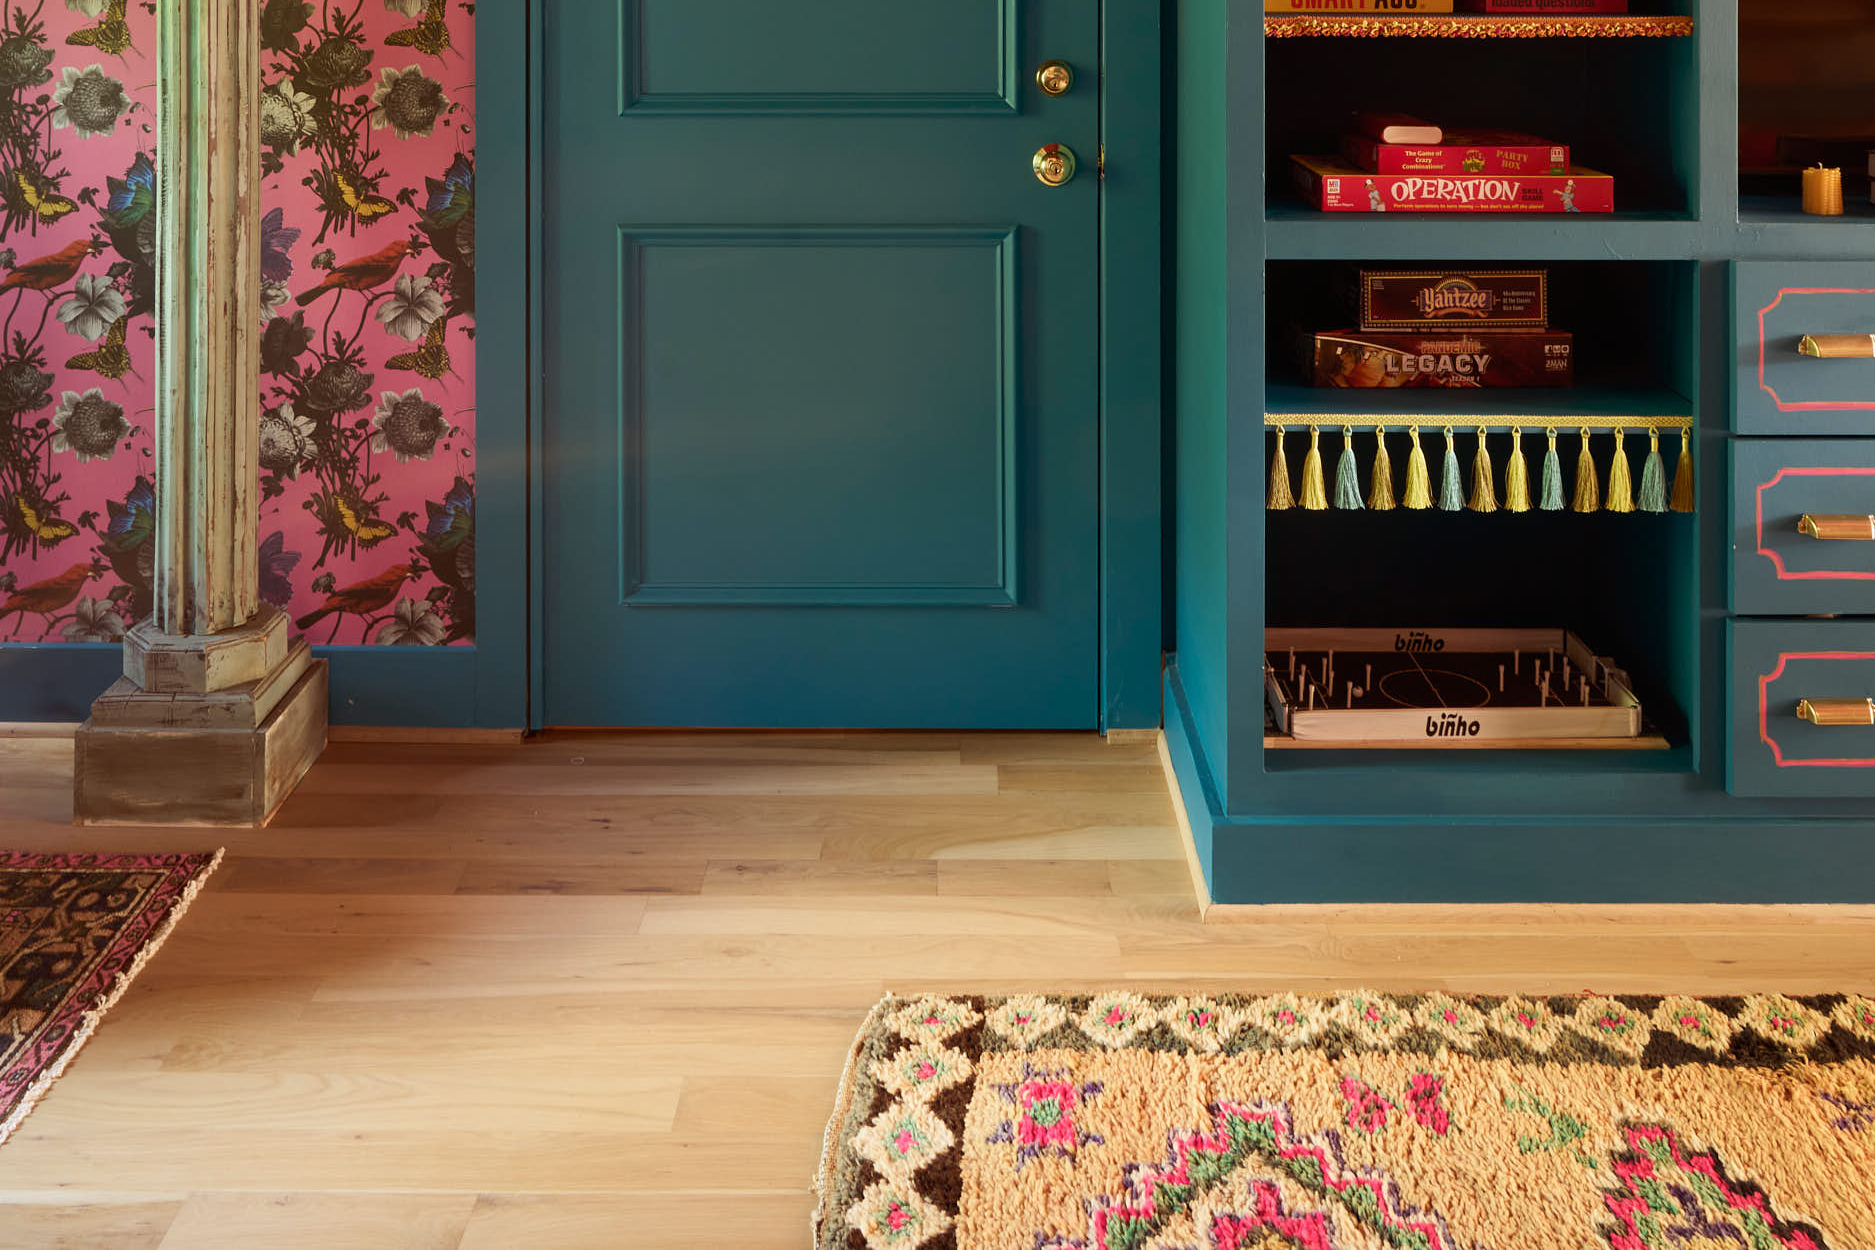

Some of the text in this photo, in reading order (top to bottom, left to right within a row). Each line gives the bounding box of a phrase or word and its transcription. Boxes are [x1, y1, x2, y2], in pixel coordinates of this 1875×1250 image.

[1497, 150, 1528, 163] PARTY
[1502, 159, 1520, 170] BOX
[1390, 177, 1520, 203] OPERATION
[1424, 287, 1487, 312] Yahtzee
[1420, 341, 1481, 354] PANDEMIC
[1384, 353, 1492, 375] LEGACY
